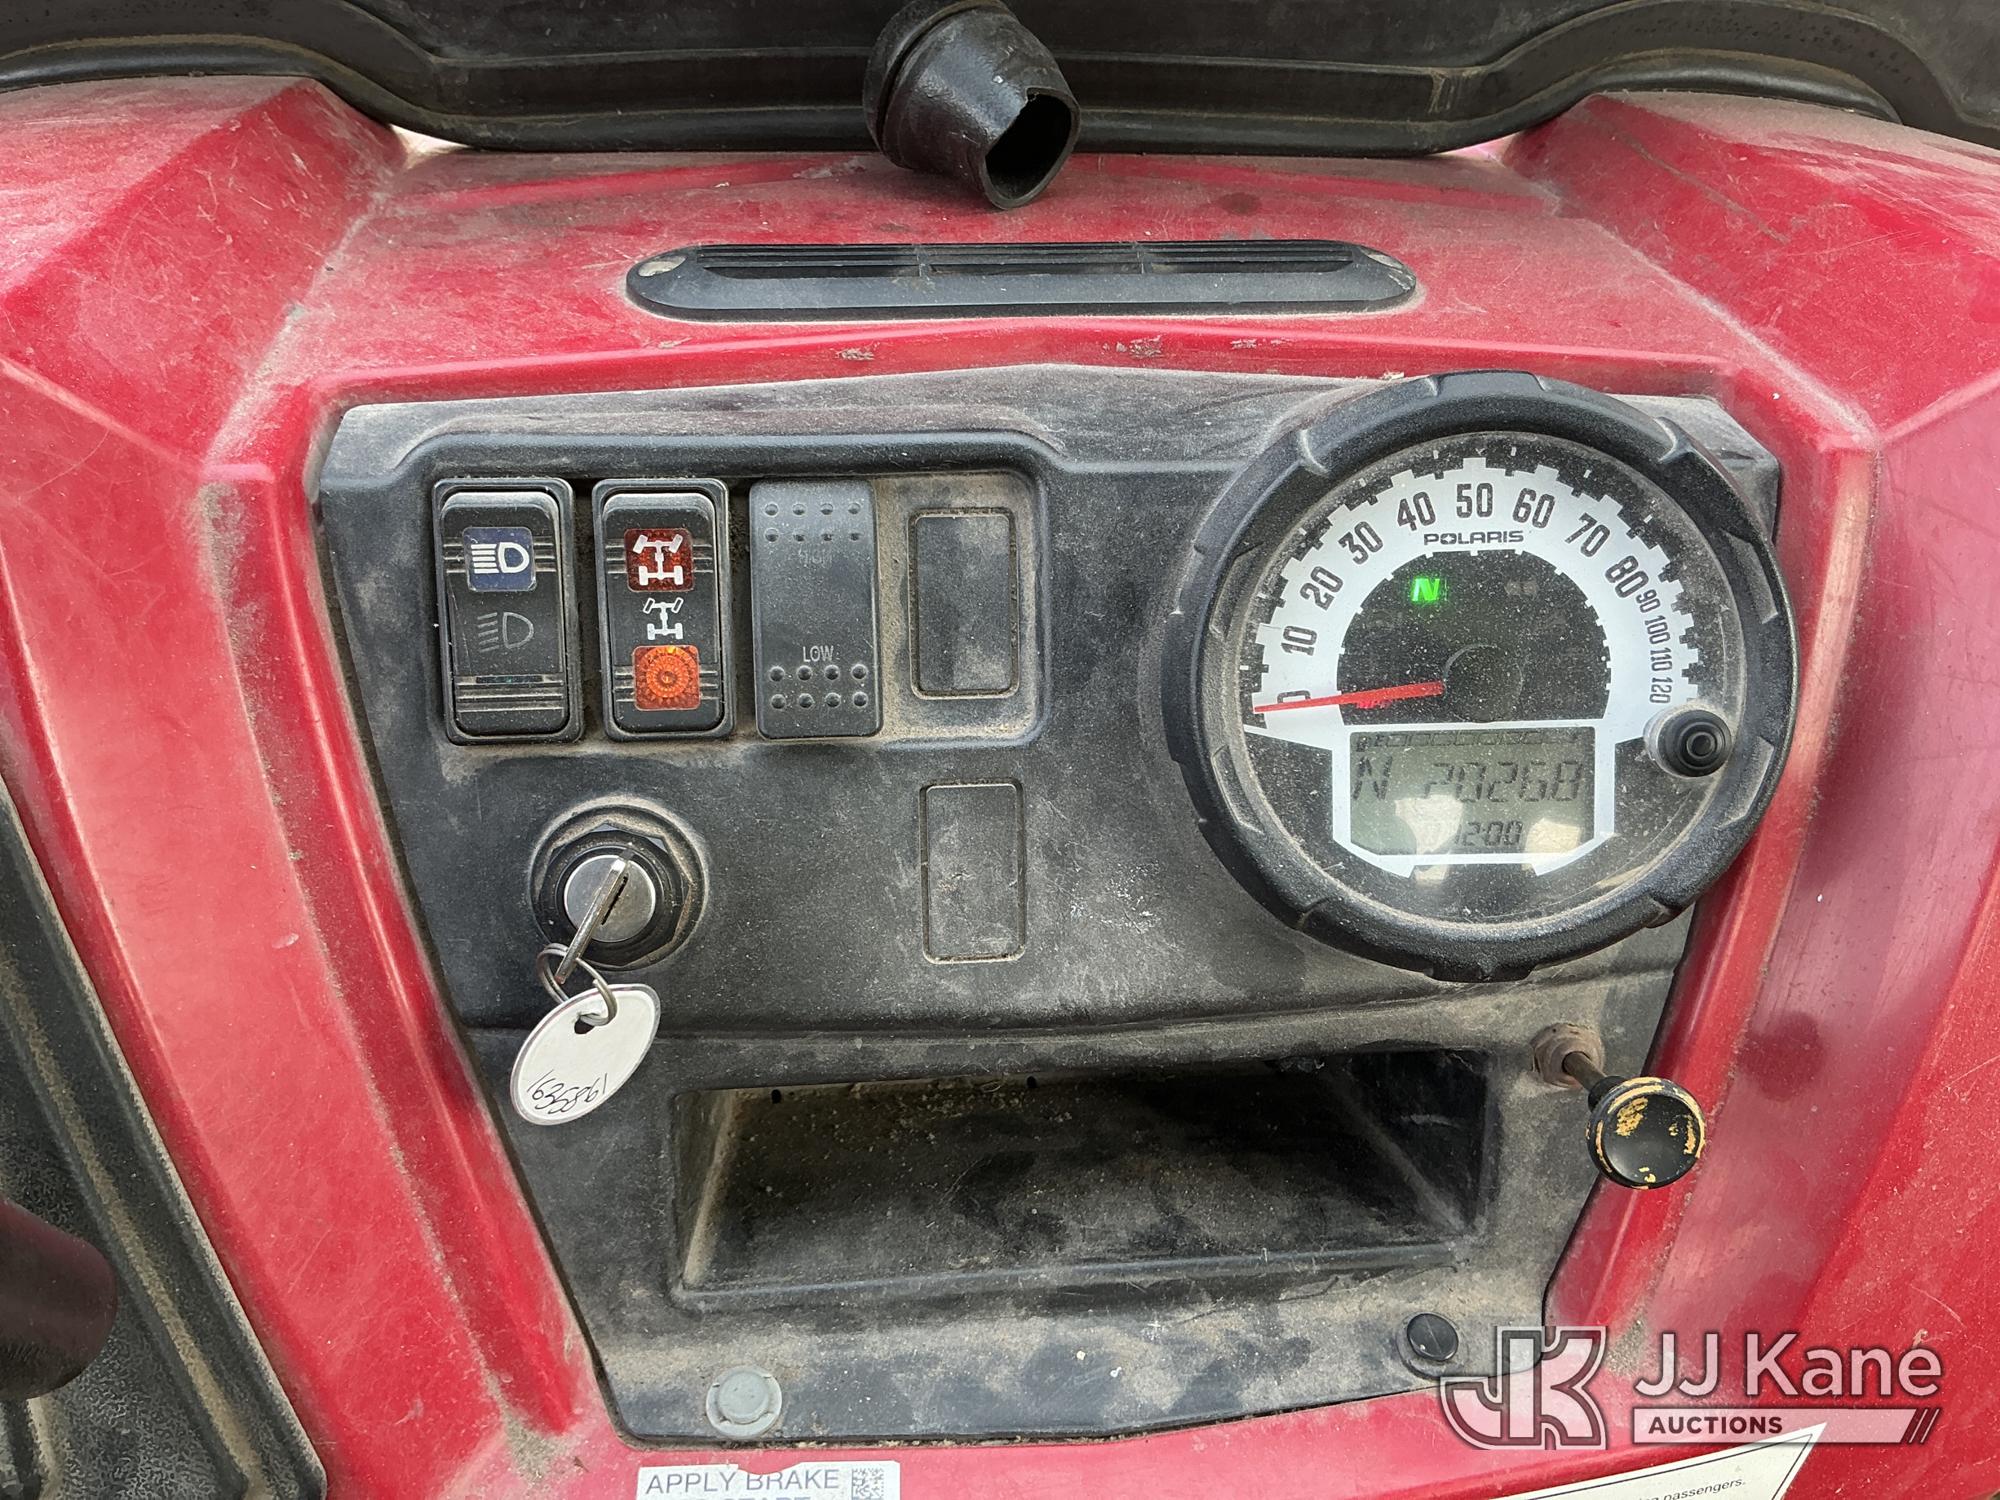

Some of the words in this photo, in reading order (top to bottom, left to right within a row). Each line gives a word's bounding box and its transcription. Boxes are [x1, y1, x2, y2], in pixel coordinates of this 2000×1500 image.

[1396, 491, 1437, 531] 40
[1456, 482, 1493, 518] 50
[1512, 487, 1555, 528] 60
[1338, 521, 1384, 565] 30
[1423, 530, 1524, 546] POLARIS
[1564, 512, 1611, 557] 70
[1300, 565, 1344, 611] 20
[1410, 577, 1440, 602] N
[1605, 555, 1650, 599] 80
[1635, 589, 1661, 614] 90
[1281, 625, 1317, 656] 10
[1644, 614, 1671, 645] 100
[802, 646, 834, 662] LOW
[1650, 647, 1673, 672] 110
[1649, 676, 1674, 704] 120
[1352, 756, 1393, 800] N
[645, 1472, 737, 1495] APPLY
[746, 1469, 840, 1491] BRAKE
